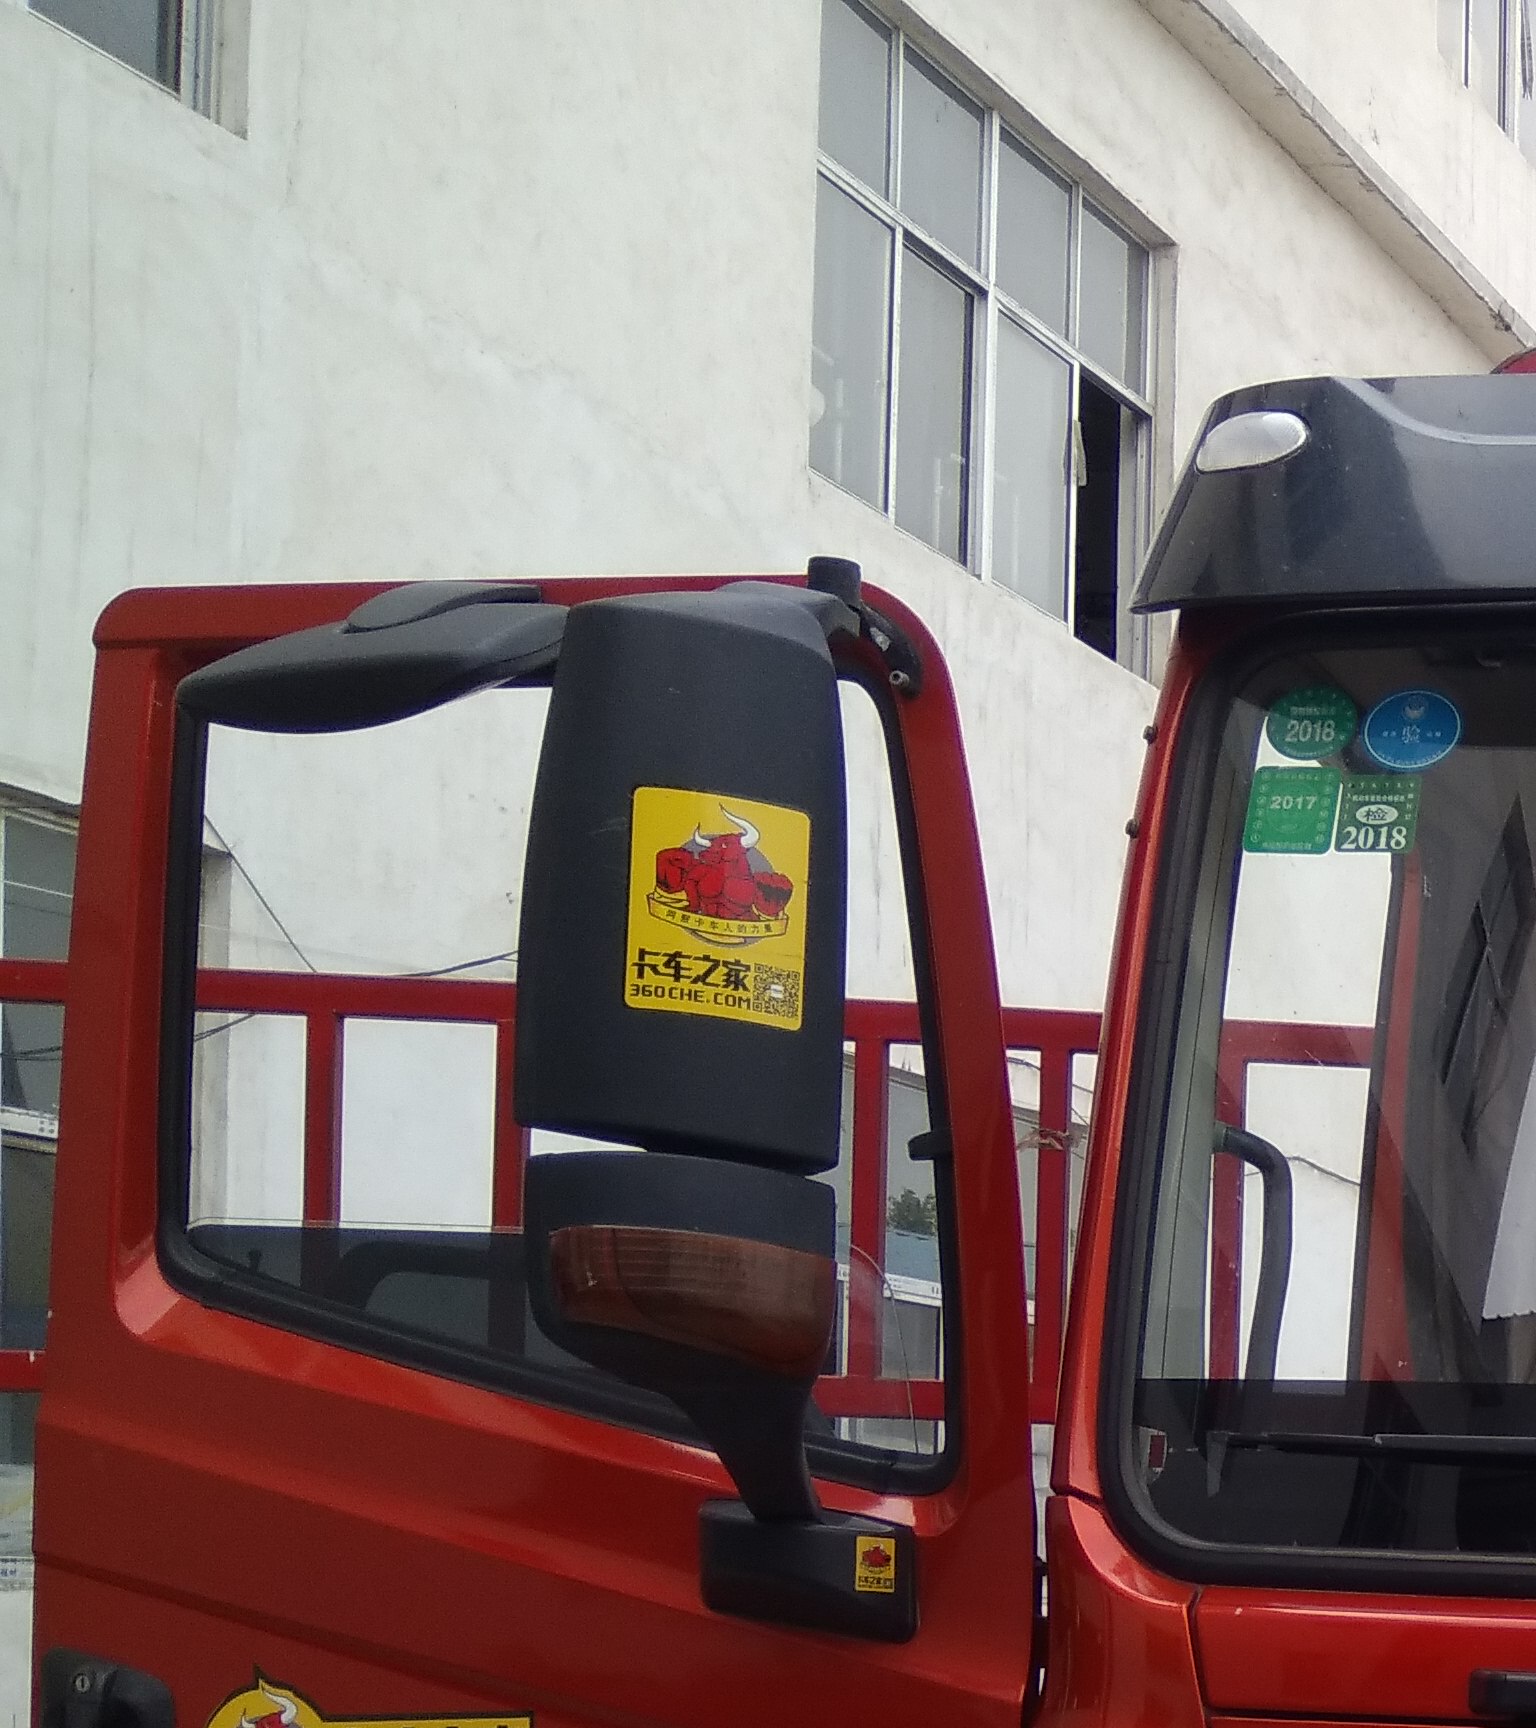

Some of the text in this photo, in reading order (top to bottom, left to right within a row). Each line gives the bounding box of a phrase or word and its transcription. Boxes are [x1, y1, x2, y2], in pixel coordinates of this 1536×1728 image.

[1285, 720, 1336, 742] 2018
[1269, 795, 1317, 810] 2017
[1361, 807, 1388, 822] 检
[1340, 826, 1407, 849] 2018
[631, 947, 751, 992] 卡车之家
[629, 983, 751, 1012] 360CHE.COM
